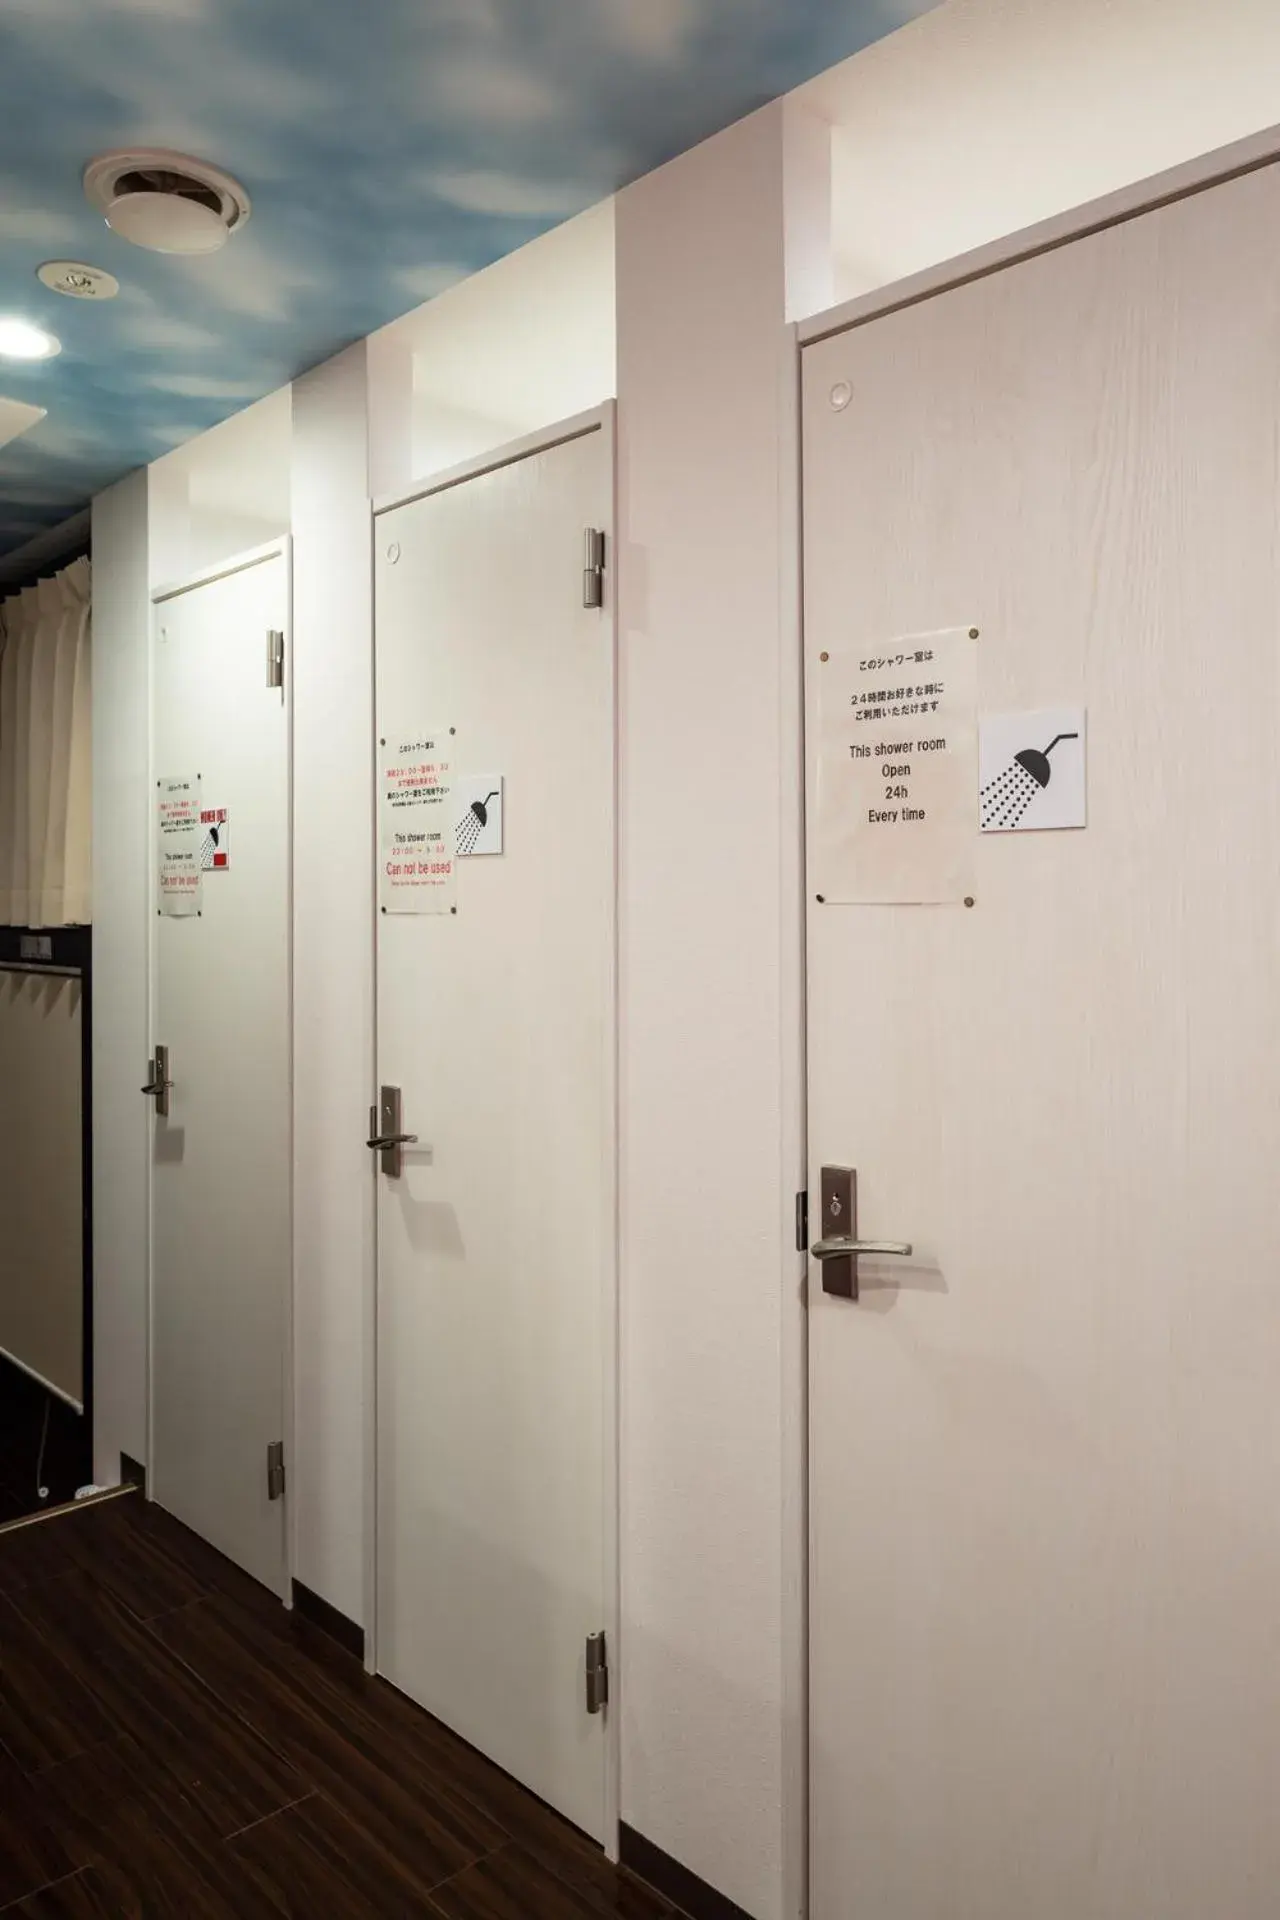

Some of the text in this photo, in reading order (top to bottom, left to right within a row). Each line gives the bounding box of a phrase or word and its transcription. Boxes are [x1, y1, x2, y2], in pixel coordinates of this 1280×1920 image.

[859, 650, 933, 671] このシャワー室は
[855, 701, 939, 720] ご利用いただけます
[850, 738, 946, 758] This shower room
[882, 764, 911, 778] Open
[885, 785, 908, 800] 24h
[868, 808, 926, 823] Every time
[407, 833, 425, 842] shower
[386, 860, 451, 875] Can not be used
